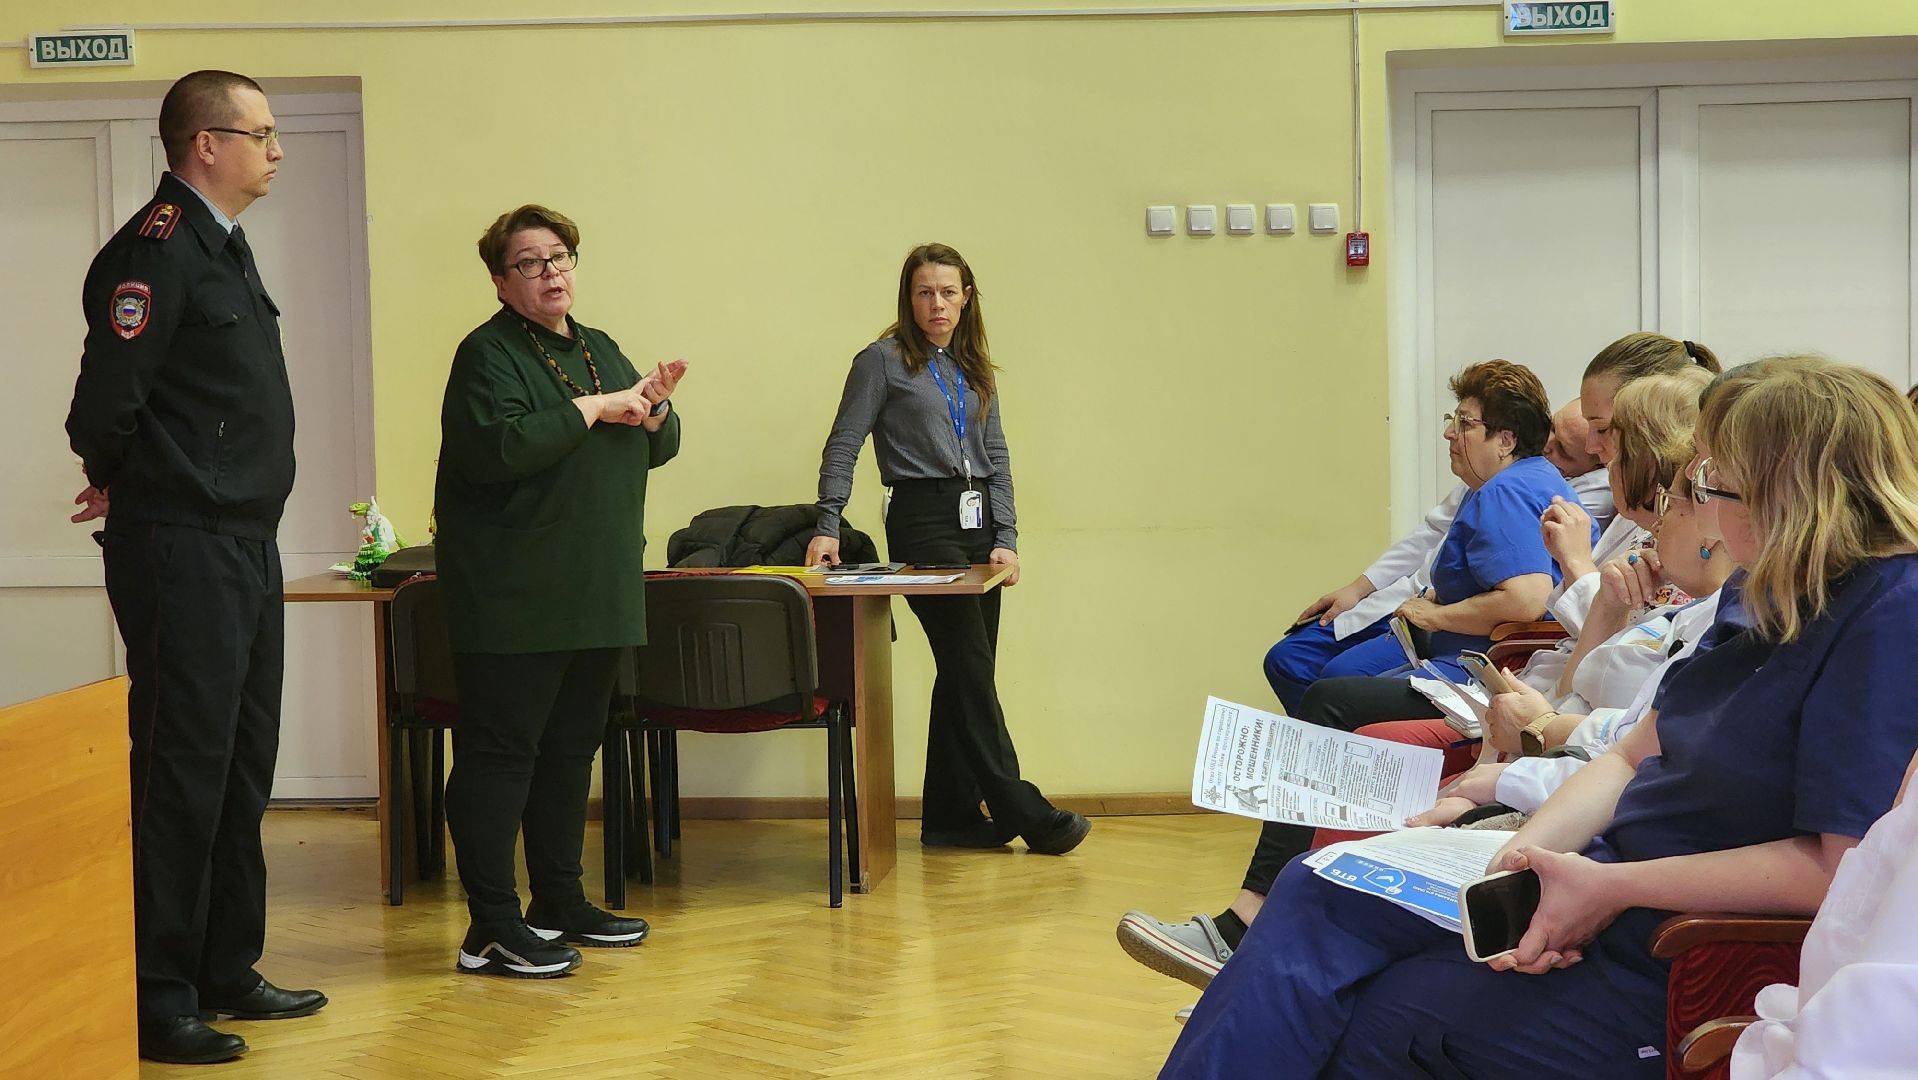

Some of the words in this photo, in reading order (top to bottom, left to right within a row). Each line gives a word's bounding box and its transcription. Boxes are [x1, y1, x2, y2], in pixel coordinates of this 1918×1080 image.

[1517, 4, 1605, 26] ВЫХОД
[41, 38, 125, 60] ВЫХОД
[1233, 725, 1249, 781] ОСТОРОЖНО:
[1246, 718, 1263, 779] МОШЕННИКИ!
[1332, 868, 1357, 883] ВТБ
